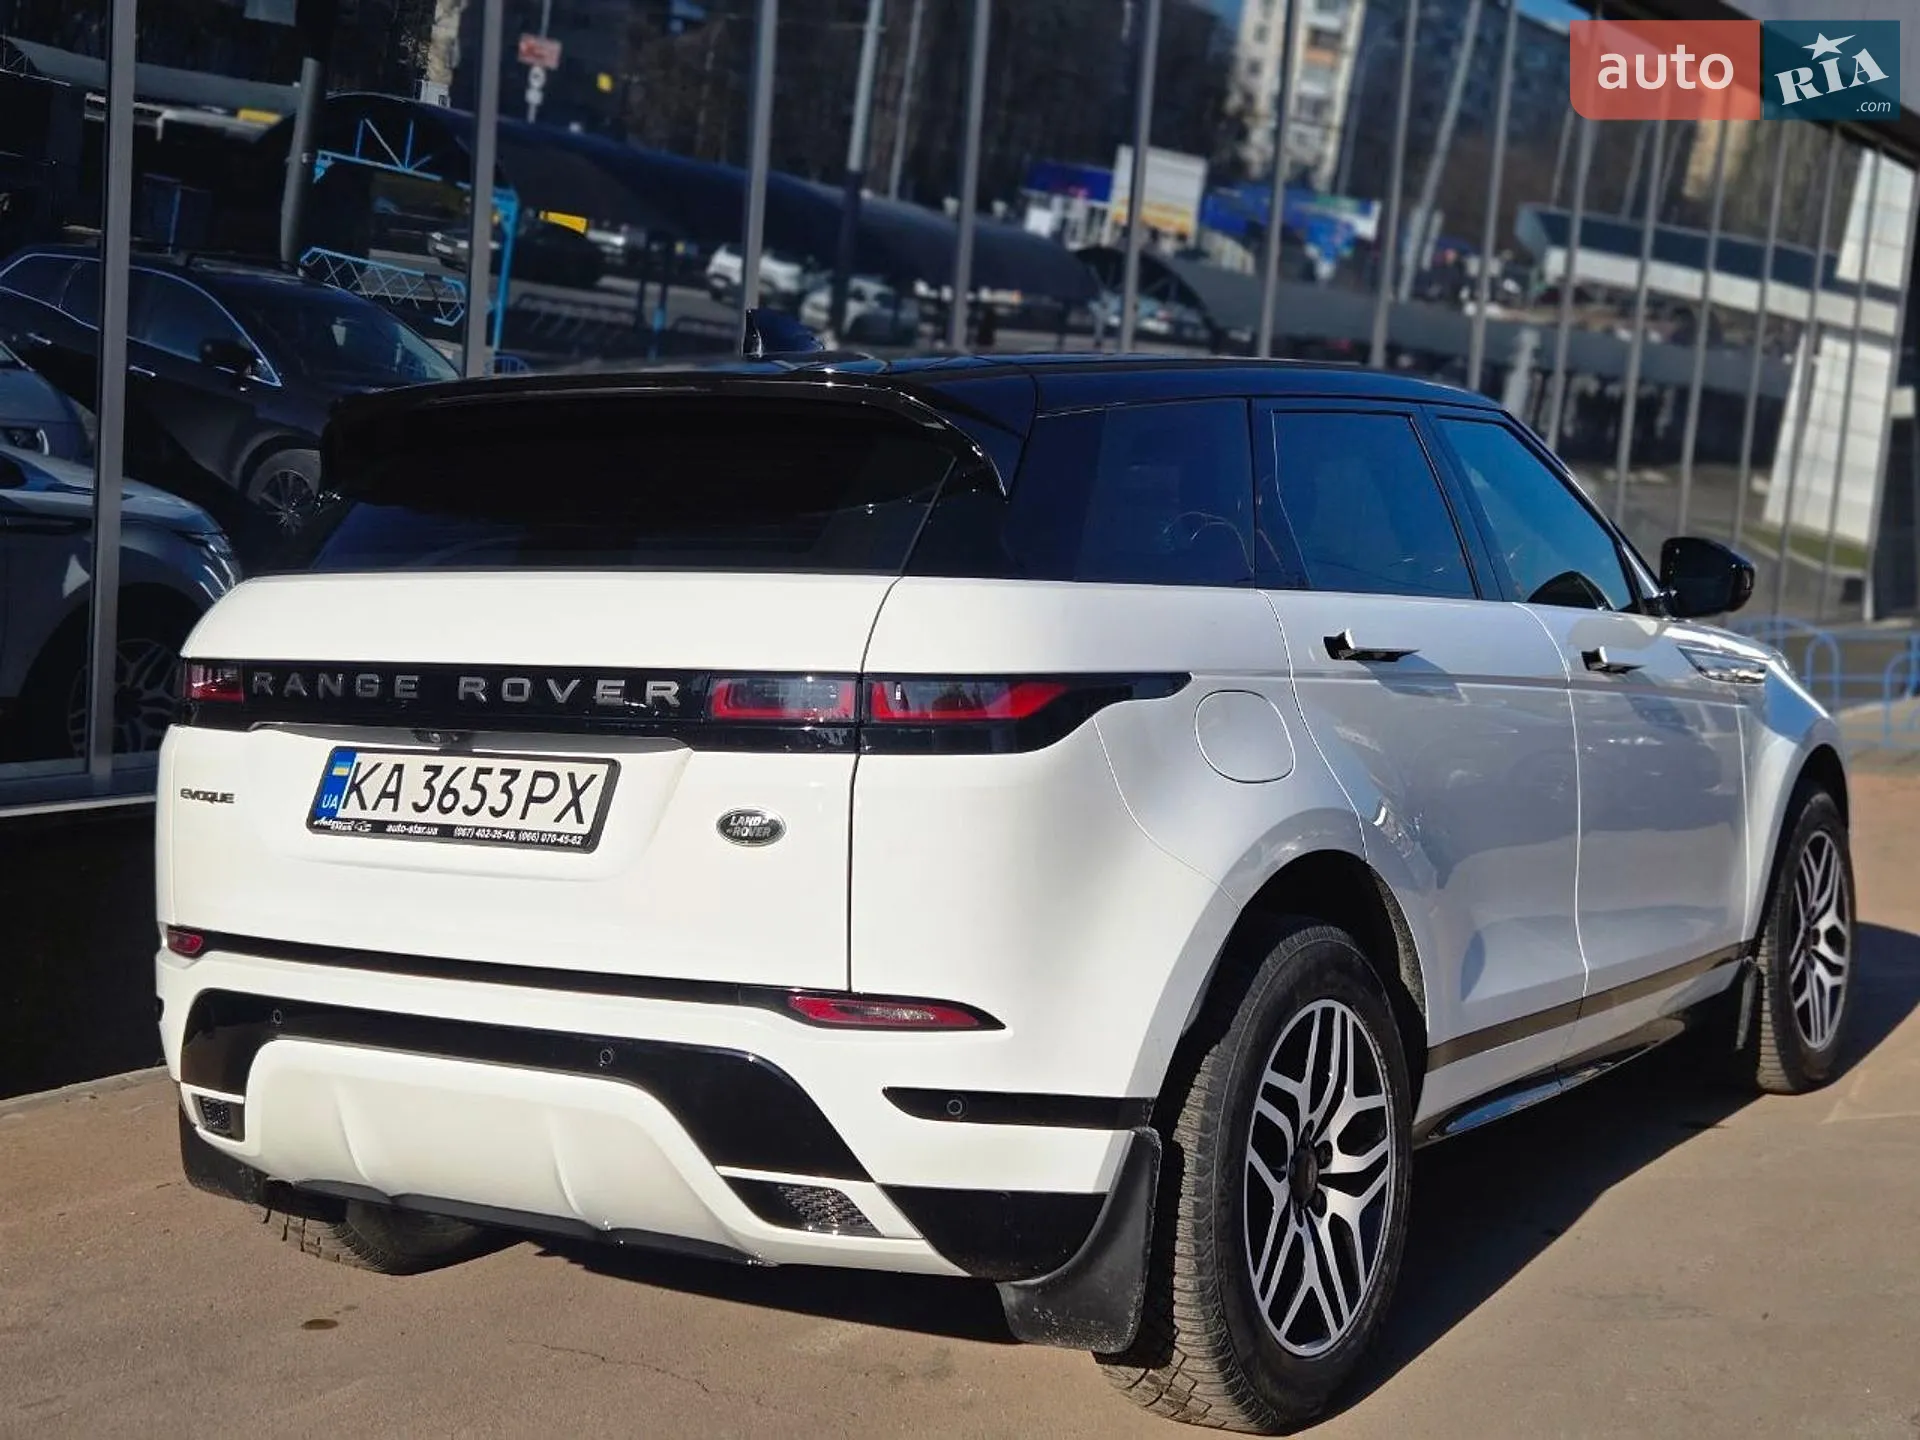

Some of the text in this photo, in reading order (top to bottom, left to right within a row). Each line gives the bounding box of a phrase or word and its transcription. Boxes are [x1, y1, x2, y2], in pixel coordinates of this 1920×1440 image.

[252, 671, 681, 707] RANGE ROVER
[180, 788, 234, 804] EVOQUE
[342, 762, 597, 825] KA 3653 PX
[321, 794, 338, 809] UA
[731, 816, 761, 826] LAND
[386, 823, 439, 835] auto-star.ua
[732, 826, 770, 837] ROVER
